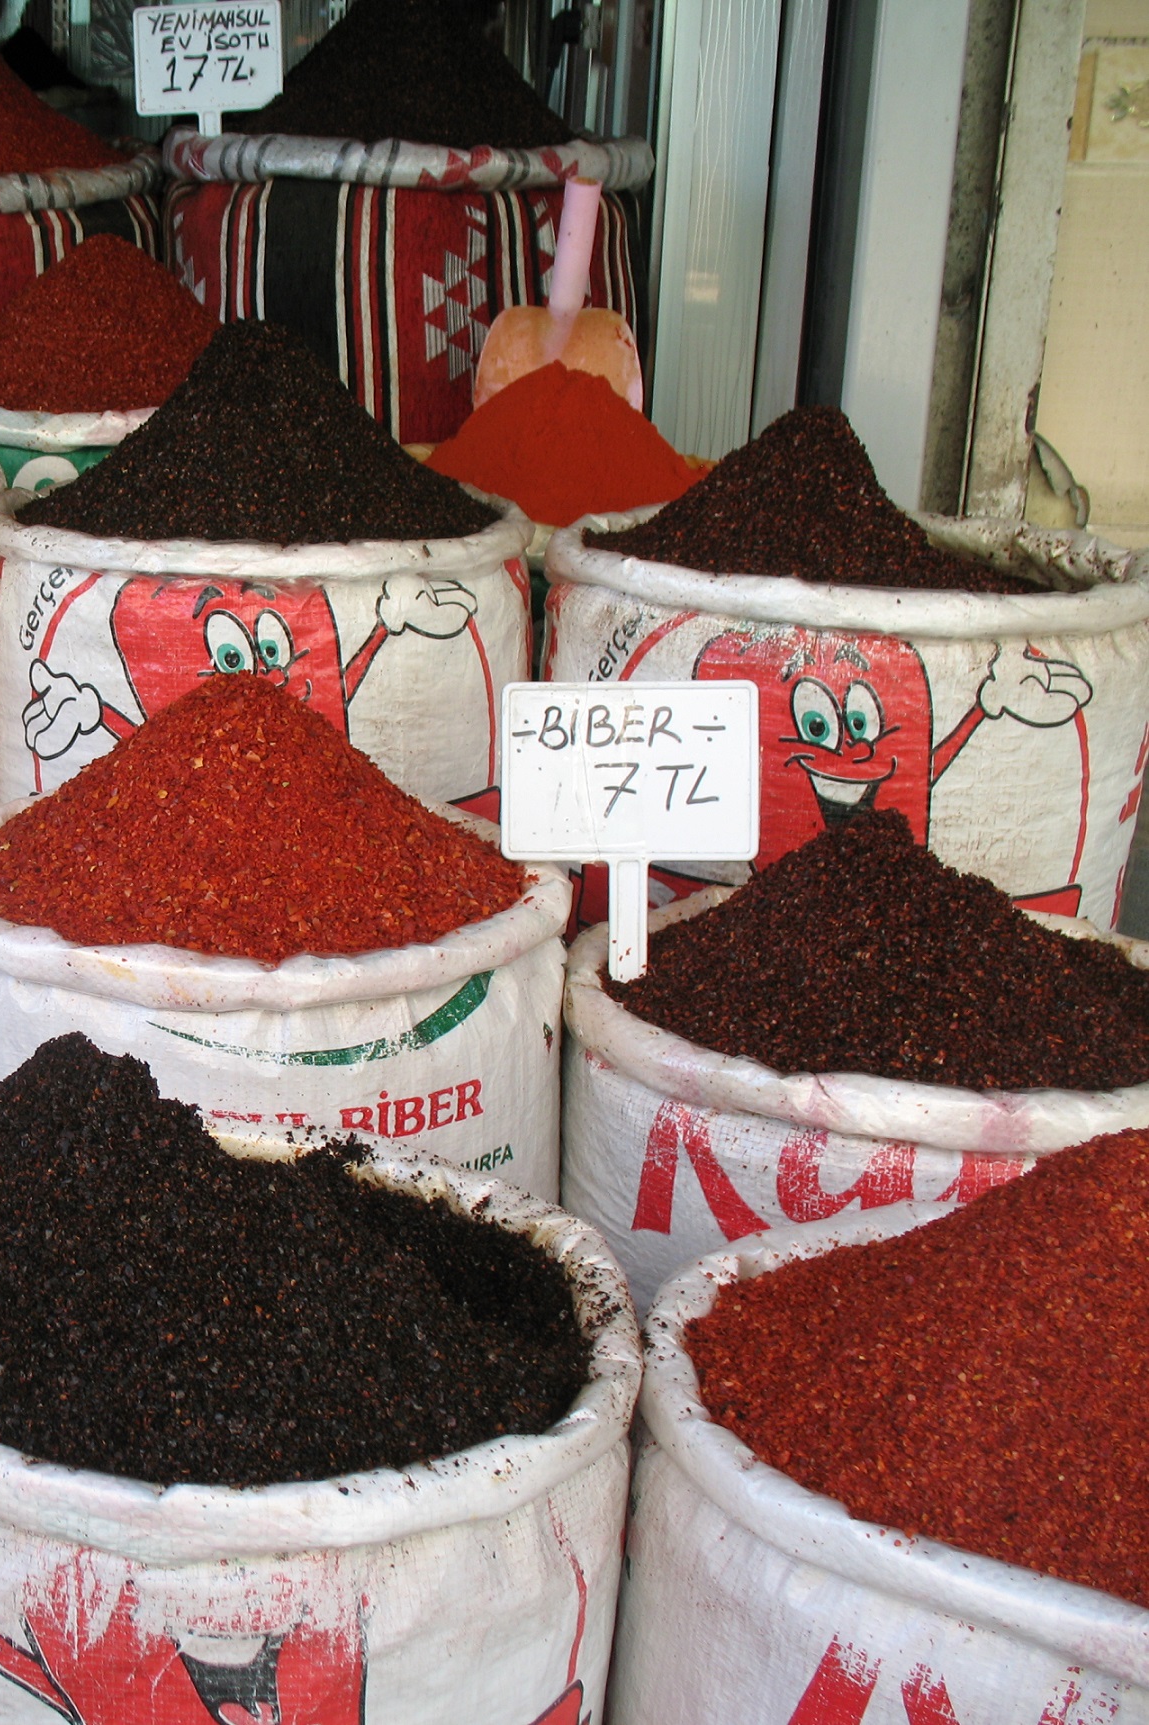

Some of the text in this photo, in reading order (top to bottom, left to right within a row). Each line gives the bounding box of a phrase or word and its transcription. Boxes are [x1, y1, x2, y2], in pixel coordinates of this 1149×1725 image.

[161, 35, 192, 53] EV
[163, 54, 208, 92] 17
[594, 762, 720, 818] 7 TL
